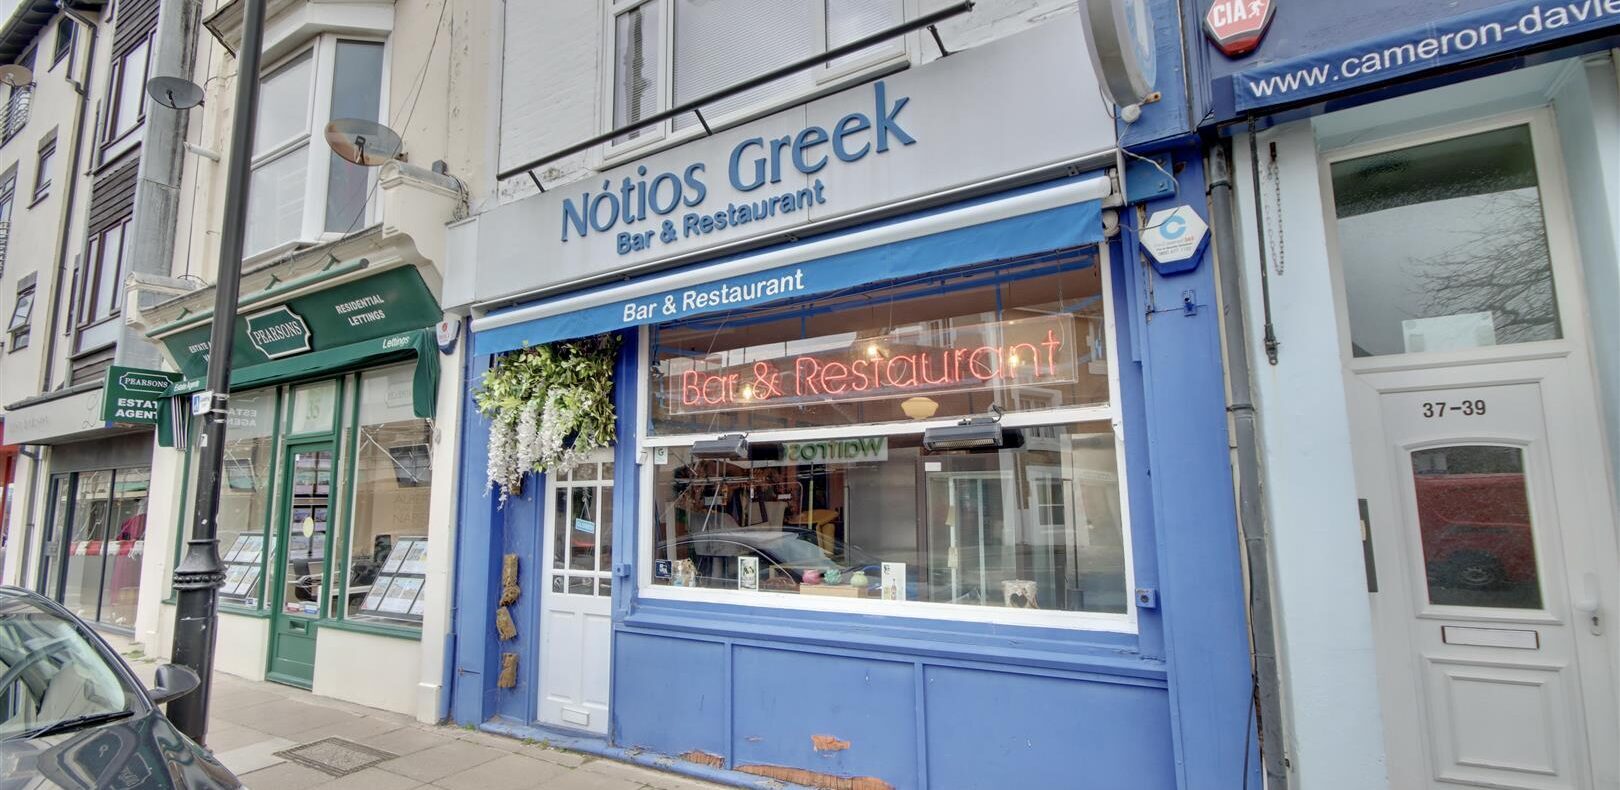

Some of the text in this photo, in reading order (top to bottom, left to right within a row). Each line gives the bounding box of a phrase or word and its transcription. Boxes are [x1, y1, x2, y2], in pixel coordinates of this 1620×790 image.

[1213, 1, 1248, 28] CIA
[560, 80, 917, 243] Nótios Greek
[616, 178, 826, 255] Bar & Restaurant
[335, 294, 385, 314] RESIDENTIAL
[623, 269, 805, 323] Bar & Restaurant
[348, 309, 386, 326] LETTINGS
[253, 320, 302, 345] PEARSONS
[382, 335, 411, 349] Lettings
[682, 329, 1063, 407] Bar & Restaurant
[124, 377, 169, 388] PEARSONS
[117, 397, 158, 409] ESTAT
[1422, 399, 1487, 418] 37-39
[114, 408, 158, 419] AGENT
